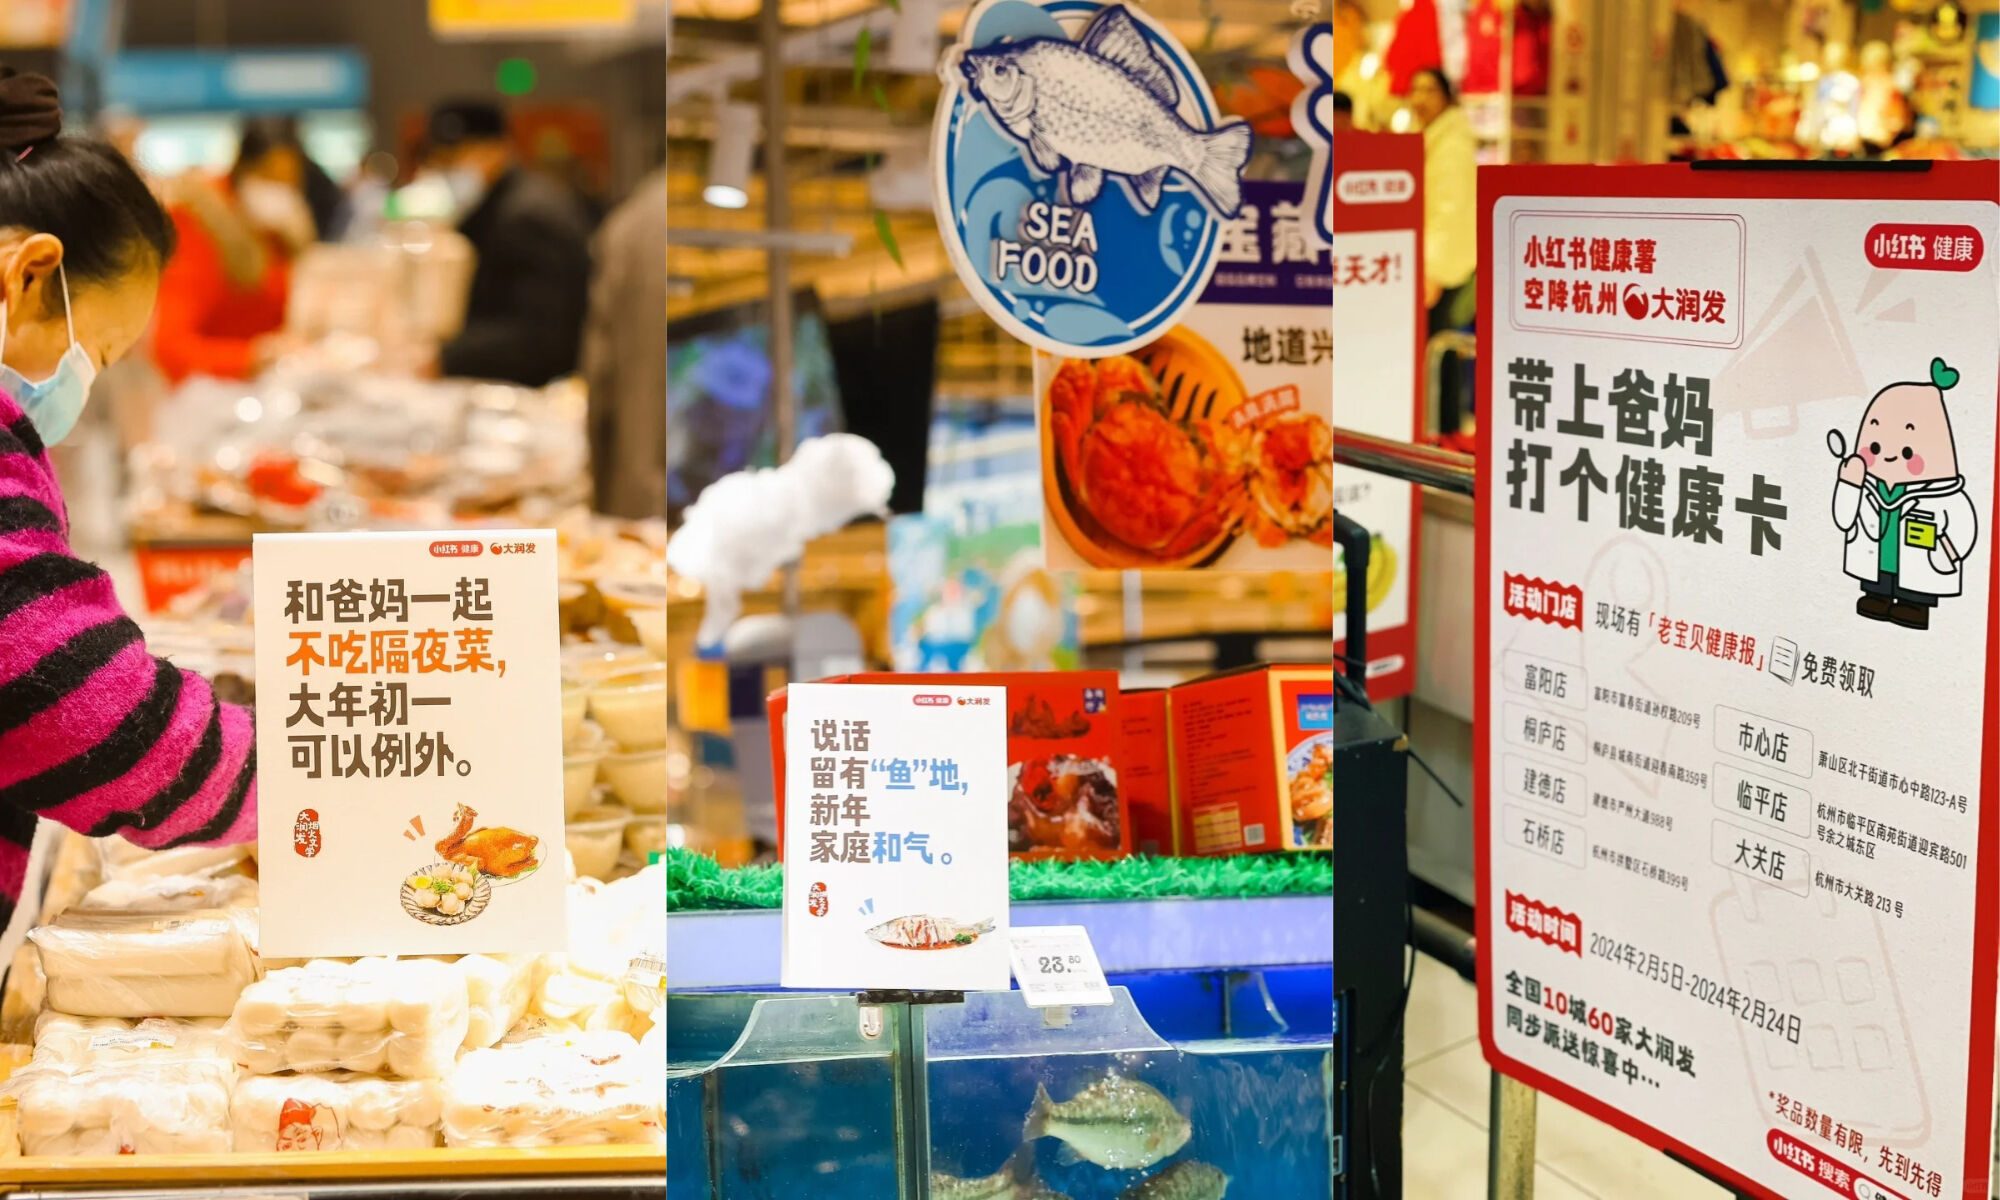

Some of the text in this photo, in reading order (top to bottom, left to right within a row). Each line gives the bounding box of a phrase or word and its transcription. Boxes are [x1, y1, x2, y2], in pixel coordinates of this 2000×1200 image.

[1025, 201, 1098, 253] SEA
[1218, 200, 1333, 265] 宝藏
[1873, 233, 1975, 262] 小红书 健康
[998, 239, 1099, 294] FOOD
[1523, 235, 1657, 274] 小红书健康薯
[1524, 278, 1727, 324] 空降杭州 大润发
[1508, 357, 1714, 457] 带上爸妈
[1506, 438, 1788, 557] 打个健康卡
[284, 576, 493, 624] 和爸妈一起
[1508, 582, 1577, 621] 活动门店
[286, 628, 506, 678] 不吃隔夜菜,
[1801, 651, 1876, 699] 免费领取
[286, 681, 452, 728] 大年初一
[1524, 663, 1568, 699] 富阳店
[287, 731, 472, 779] 可以例外。
[811, 719, 871, 752] 说话
[1523, 714, 1567, 751] 桐庐店
[1738, 721, 1789, 764] 市心店
[1523, 767, 1567, 804] 建德店
[1737, 778, 1788, 823] 临平店
[1817, 750, 1968, 815] 萧山区北干街道市心中路123-A号
[810, 793, 871, 827] 新年
[810, 830, 953, 865] 家庭和气。
[1522, 817, 1565, 856] 石桥店
[1816, 801, 1968, 870] 杭州市临平区南苑街道迎宾路501
[1816, 824, 1877, 860] 号余之城东区
[1735, 838, 1786, 882] 大关店
[1815, 870, 1904, 919] 杭州市大关路 213 号
[1509, 899, 1577, 947] 活动时间
[1590, 932, 1801, 1045] 2024年2月5日-2024年2月24日
[1505, 970, 1697, 1079] 全国10城60家大润发
[1773, 1136, 1851, 1192] 小红书 搜索
